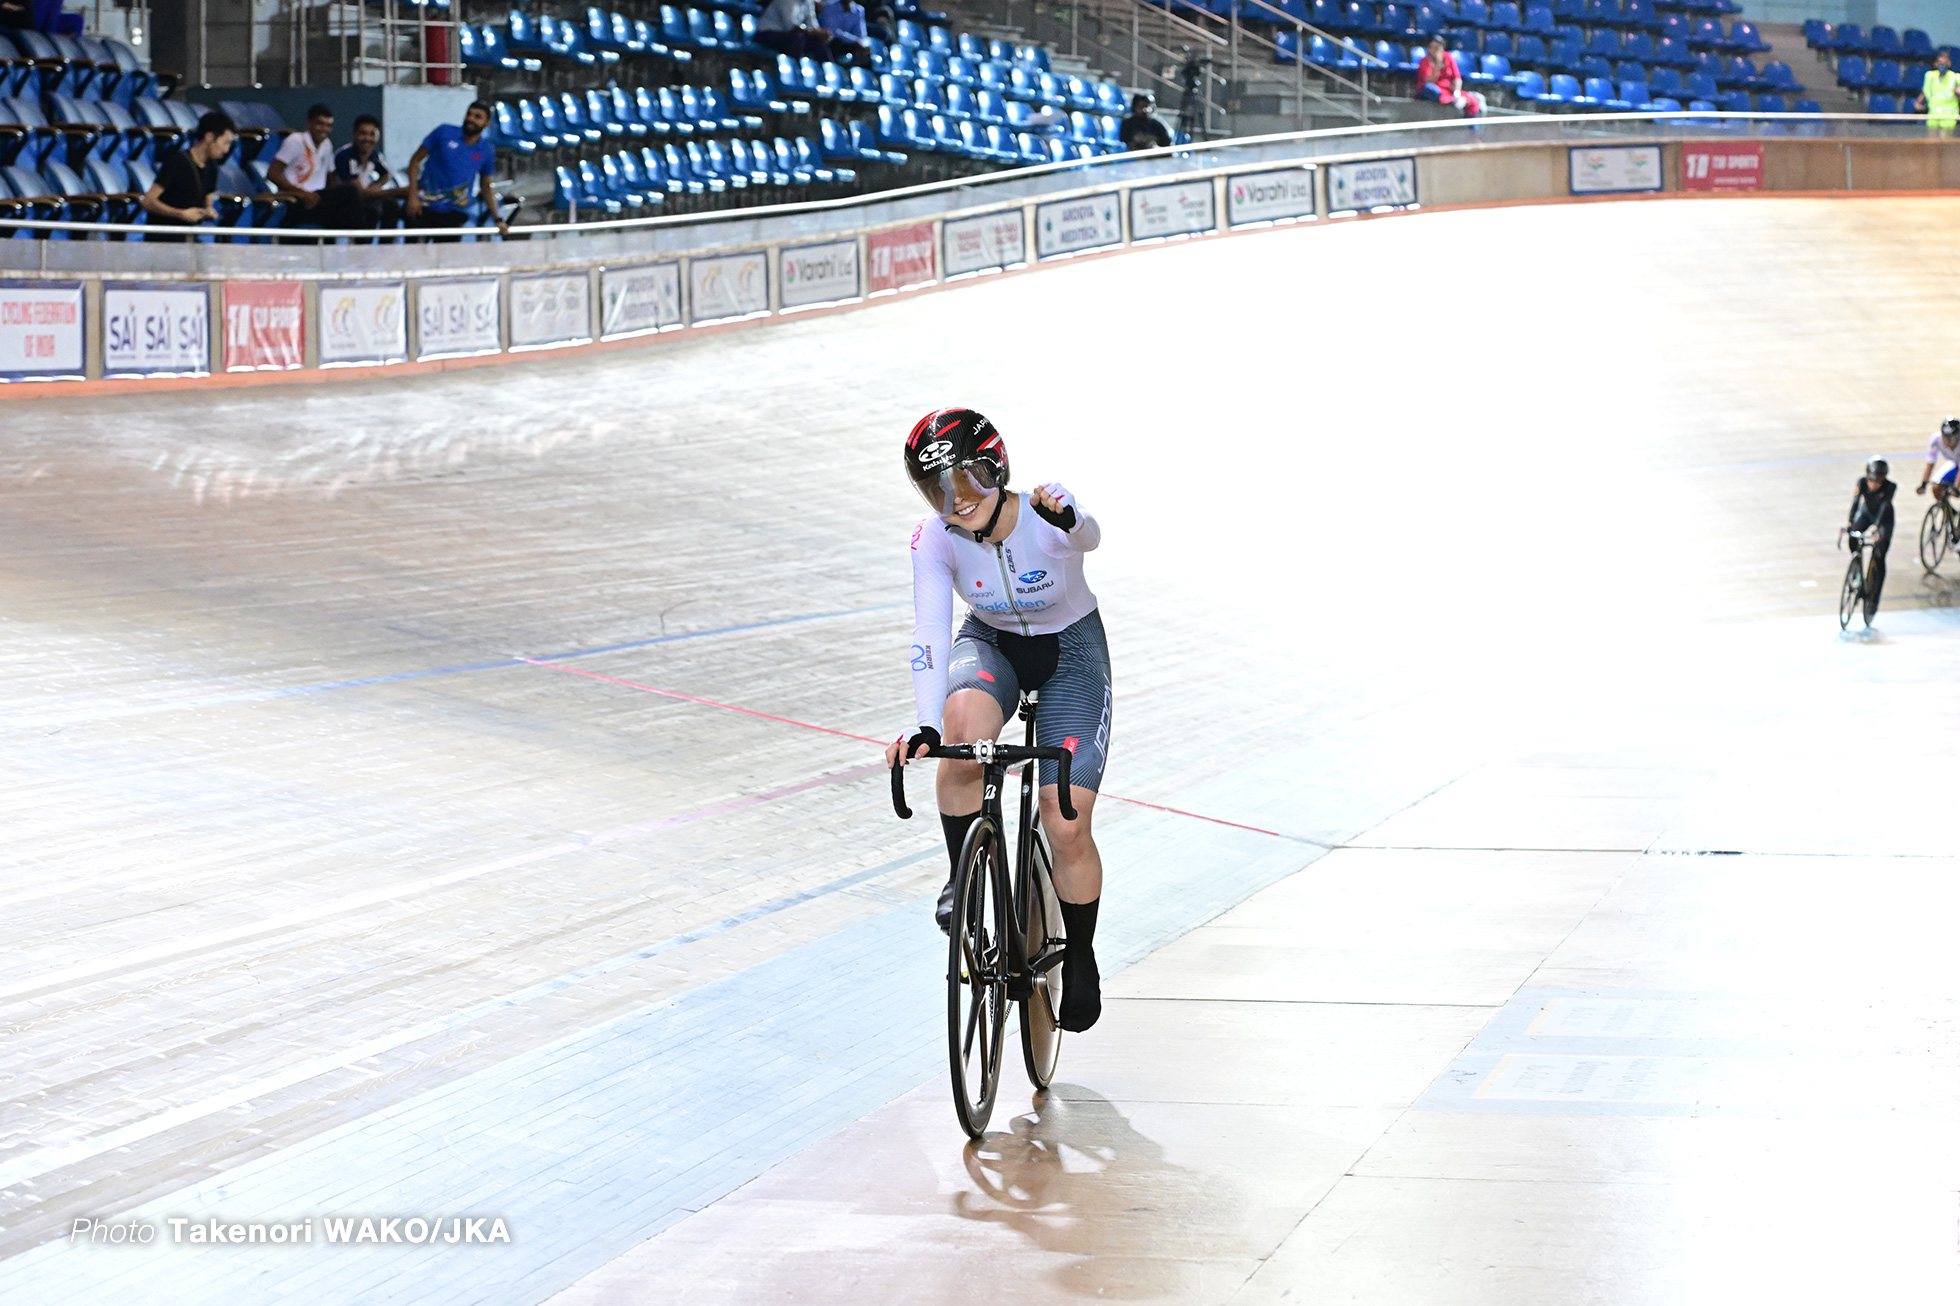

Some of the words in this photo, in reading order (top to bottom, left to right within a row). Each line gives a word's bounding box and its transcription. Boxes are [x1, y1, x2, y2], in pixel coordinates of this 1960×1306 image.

[1245, 181, 1288, 204] Varahi
[796, 253, 836, 282] Varahi
[1016, 580, 1054, 594] SUBARU
[975, 599, 1046, 612] Rakuten
[925, 644, 935, 670] KEIRIN
